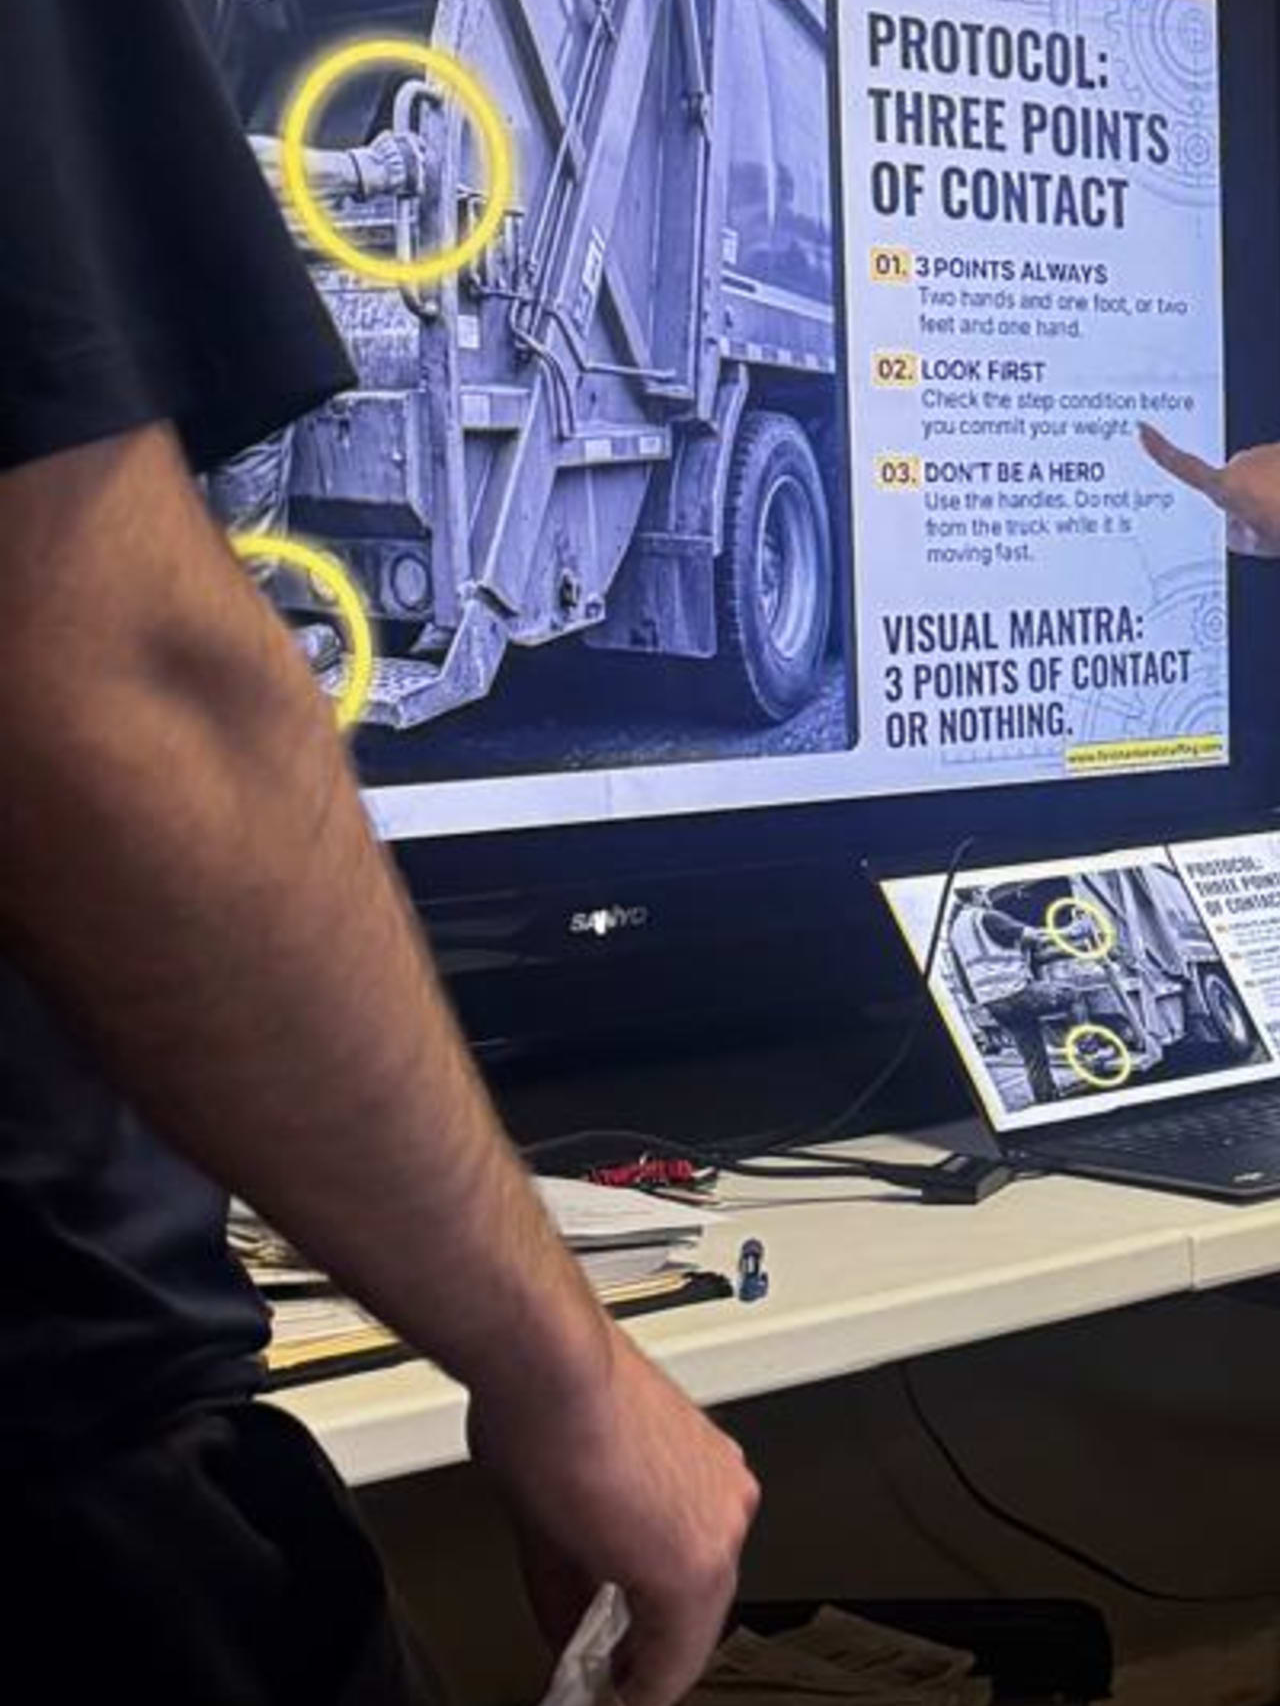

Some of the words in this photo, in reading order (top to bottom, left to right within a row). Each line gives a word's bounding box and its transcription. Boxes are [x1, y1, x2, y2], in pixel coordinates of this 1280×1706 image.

[868, 11, 1108, 90] PROTOCOL:
[868, 87, 1007, 153] THREE
[1023, 101, 1169, 165] POINTS
[872, 160, 925, 217] OF
[941, 166, 1129, 230] CONTACT
[875, 254, 907, 275] 01.
[916, 256, 930, 277] 3
[934, 257, 1015, 281] POINTS
[1020, 261, 1108, 284] ALWAYS
[919, 287, 955, 307] Two
[959, 287, 1015, 310] hands
[1020, 292, 1053, 311] and
[1058, 297, 1089, 312] one
[1093, 294, 1131, 317] foot,
[1136, 299, 1152, 314] or
[1156, 298, 1187, 315] two
[920, 316, 955, 335] feet
[960, 317, 994, 335] and
[998, 320, 1031, 336] one
[1035, 318, 1082, 338] hand.
[877, 359, 913, 380] 02.
[921, 360, 980, 381] LOOK
[988, 362, 1045, 382] FIRST
[922, 390, 978, 410] Check
[983, 392, 1011, 410] the
[1017, 393, 1054, 414] step
[1059, 394, 1137, 411] condition
[1140, 394, 1194, 411] before
[922, 420, 955, 440] you
[959, 418, 1025, 436] commit
[1030, 420, 1068, 440] your
[882, 463, 917, 483] 03.
[925, 462, 990, 484] DON'T
[998, 463, 1023, 483] BE
[1029, 463, 1043, 481] A
[1049, 462, 1105, 482] HERO
[925, 493, 967, 510] Use
[970, 492, 994, 509] the
[999, 492, 1069, 510] handles.
[1075, 493, 1098, 508] Do
[1100, 493, 1129, 507] not
[1133, 493, 1174, 511] jump
[926, 520, 967, 536] from
[972, 520, 1001, 535] the
[1006, 519, 1049, 535] truck
[1056, 517, 1099, 534] while
[1104, 517, 1114, 533] it
[1119, 518, 1132, 534] is
[928, 545, 992, 565] moving
[996, 544, 1035, 563] fast.
[883, 612, 998, 654] VISUAL
[1009, 607, 1144, 650] MANTRA:
[886, 668, 903, 702] 3
[914, 660, 1017, 700] POINTS
[1029, 657, 1061, 691] OF
[1072, 650, 1191, 689] CONTACT
[886, 711, 927, 747] OR
[939, 704, 1073, 745] NOTHING.
[570, 905, 647, 933] SANYO
